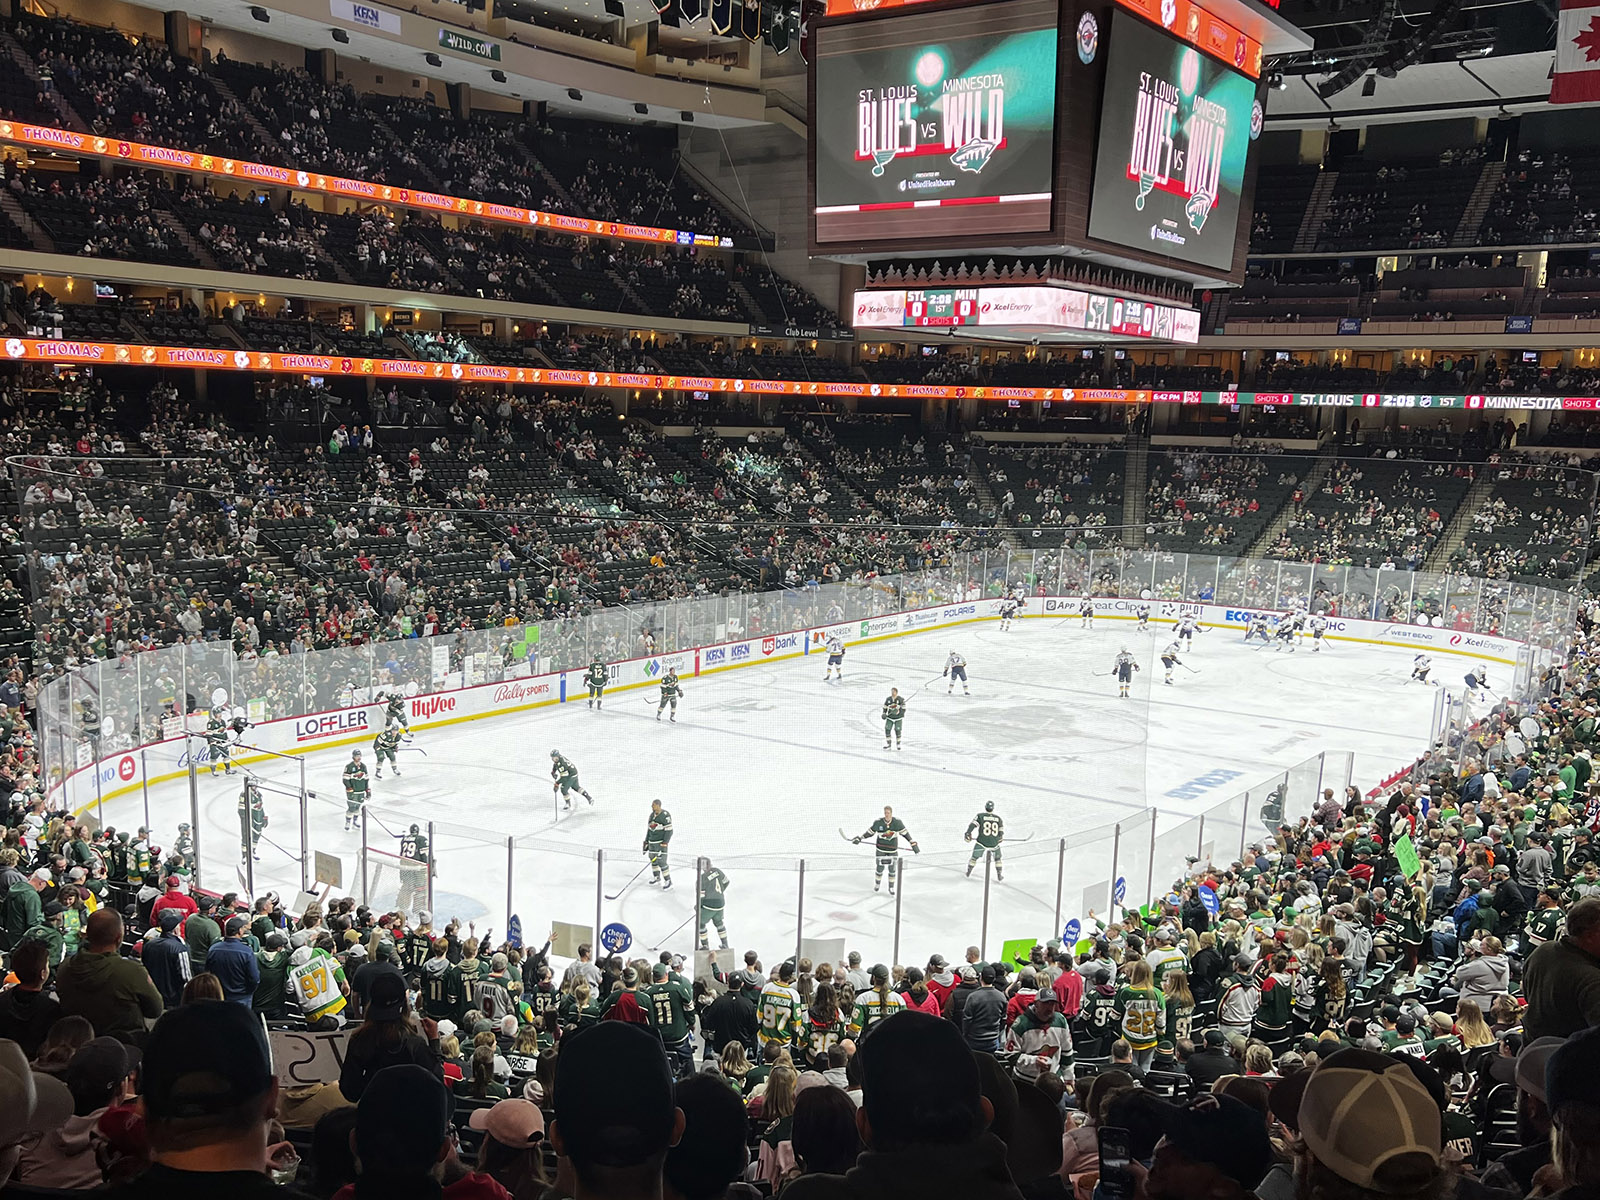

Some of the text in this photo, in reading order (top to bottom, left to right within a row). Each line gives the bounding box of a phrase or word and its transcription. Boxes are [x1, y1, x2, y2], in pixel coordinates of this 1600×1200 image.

[353, 4, 379, 22] KFAN
[448, 33, 492, 58] WILD.COM
[942, 74, 1004, 93] MINNESOTA
[859, 84, 918, 102] ST. LOUIS
[1154, 78, 1180, 105] LOUIS
[1192, 94, 1227, 126] MINNESOTA
[943, 88, 1004, 149] WILD
[858, 97, 917, 156] BLUES
[921, 122, 937, 138] VS
[1130, 90, 1178, 185] BLUES
[1174, 148, 1184, 171] VS
[907, 290, 976, 301] STL MIN
[930, 294, 952, 304] 2:08
[912, 301, 970, 317] 0 0
[1010, 304, 1032, 312] Energy
[923, 317, 928, 325] 0
[1112, 302, 1153, 331] 0 0
[785, 328, 800, 336] Club
[1300, 394, 1375, 406] ST. LOUIS 0
[1382, 395, 1415, 407] 2:08
[1439, 398, 1456, 406] 1ST
[1469, 396, 1562, 409] 0 MINNESOTA
[1564, 400, 1591, 408] SHOTS
[944, 606, 975, 619] POLARIS
[863, 620, 897, 633] enterprise
[775, 634, 797, 649] bank
[1465, 637, 1508, 652] Xcel Energy
[706, 647, 726, 661] KFAN
[731, 644, 750, 656] KFAN
[594, 669, 603, 678] 12
[494, 683, 549, 704] Bally SPORTS
[296, 710, 368, 736] LOFFLER
[983, 821, 998, 837] 89
[402, 842, 416, 857] 29
[716, 878, 723, 894] 4
[607, 928, 627, 938] Cheer
[1536, 922, 1546, 933] 17
[608, 936, 624, 945] Lod
[413, 945, 429, 967] 17
[300, 968, 327, 999] 97
[430, 980, 442, 1001] 11
[483, 997, 494, 1018] 9
[767, 995, 791, 1006] KAPRIZOV
[655, 1001, 672, 1024] 11
[763, 1004, 791, 1031] 97
[869, 1007, 899, 1015] ZUCCELLO
